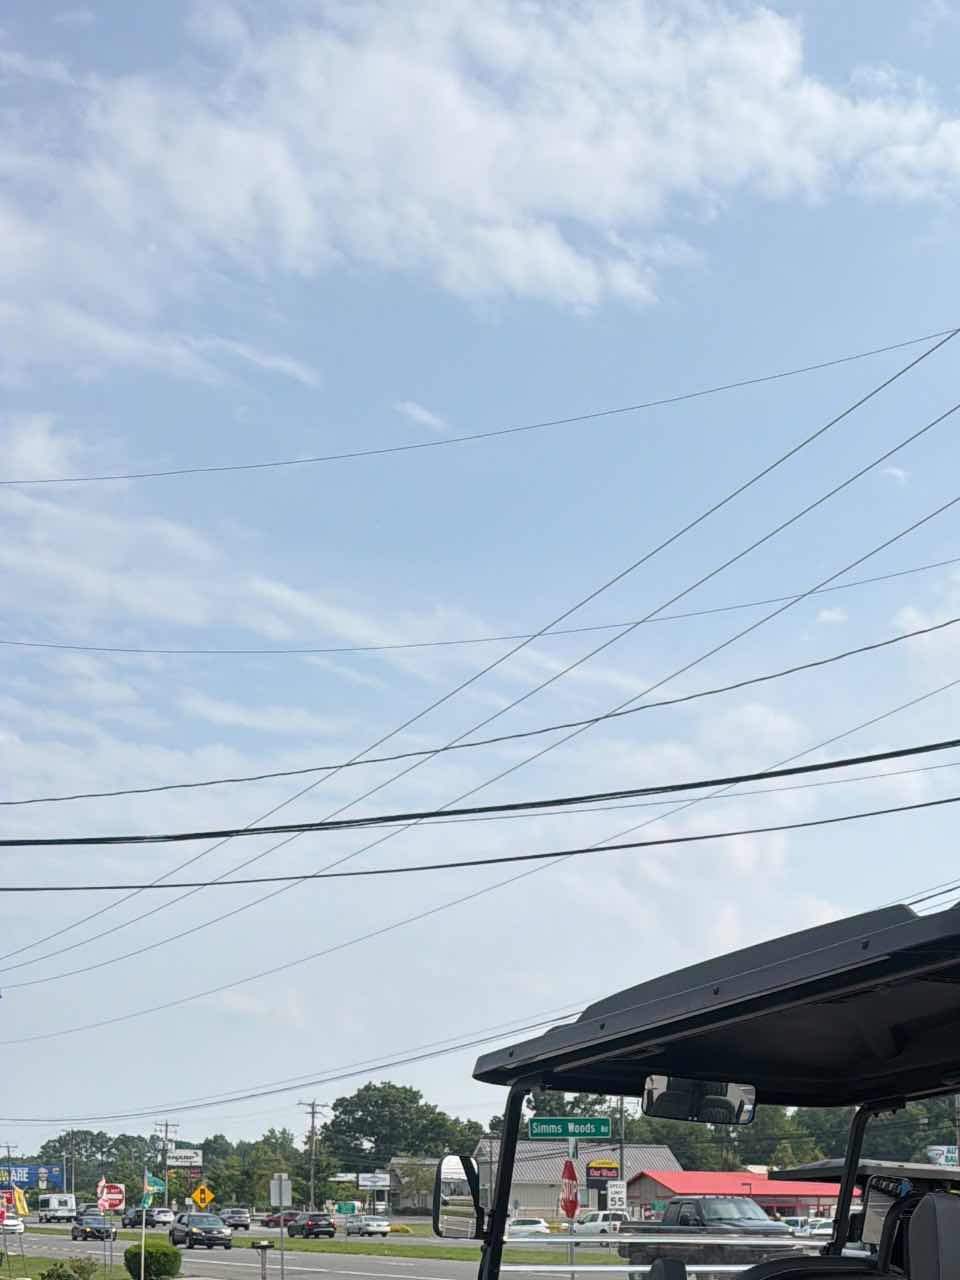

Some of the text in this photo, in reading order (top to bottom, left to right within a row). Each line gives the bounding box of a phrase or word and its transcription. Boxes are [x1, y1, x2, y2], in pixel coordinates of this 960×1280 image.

[532, 1122, 563, 1134] Simms
[567, 1122, 596, 1133] Woods
[610, 1197, 625, 1207] 55
